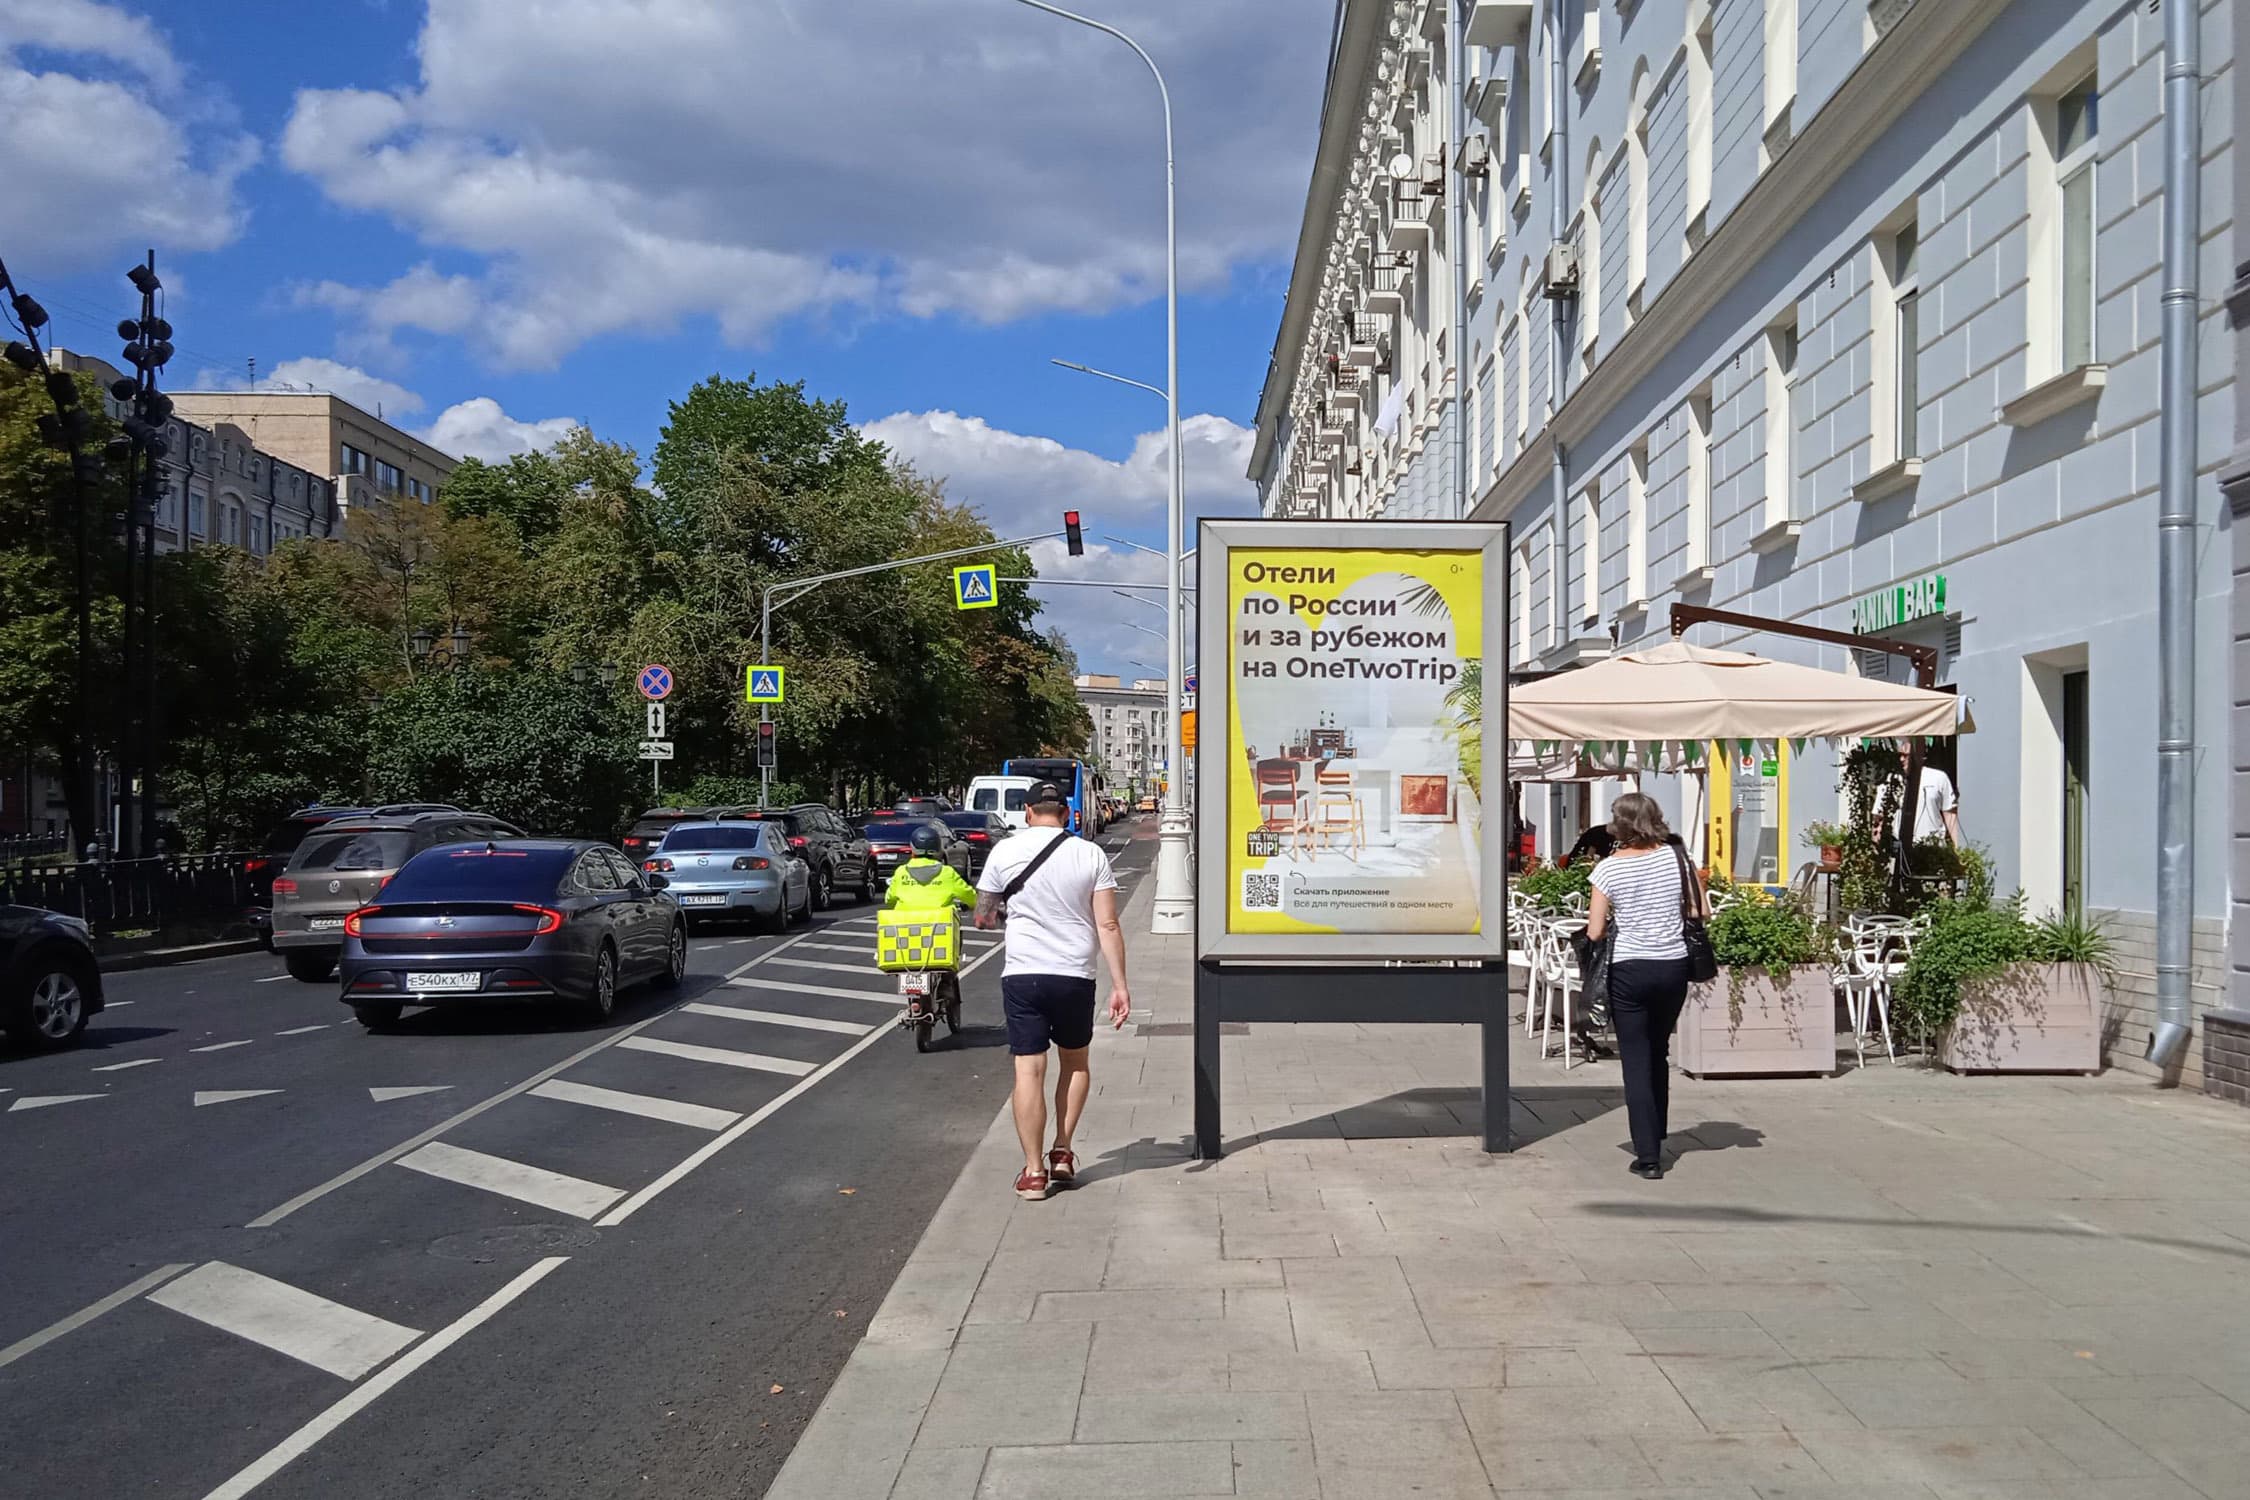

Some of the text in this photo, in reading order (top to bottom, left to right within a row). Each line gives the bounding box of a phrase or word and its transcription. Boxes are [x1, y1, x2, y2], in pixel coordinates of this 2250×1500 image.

[1243, 561, 1335, 584] Отели
[1243, 594, 1397, 617] по России
[1849, 574, 1938, 635] PANINI BAR
[1243, 624, 1447, 652] и за рубежом
[1242, 657, 1457, 685] на OneTwoTrip
[1248, 841, 1279, 856] TRIP!
[1293, 887, 1390, 897] Скачать приложение
